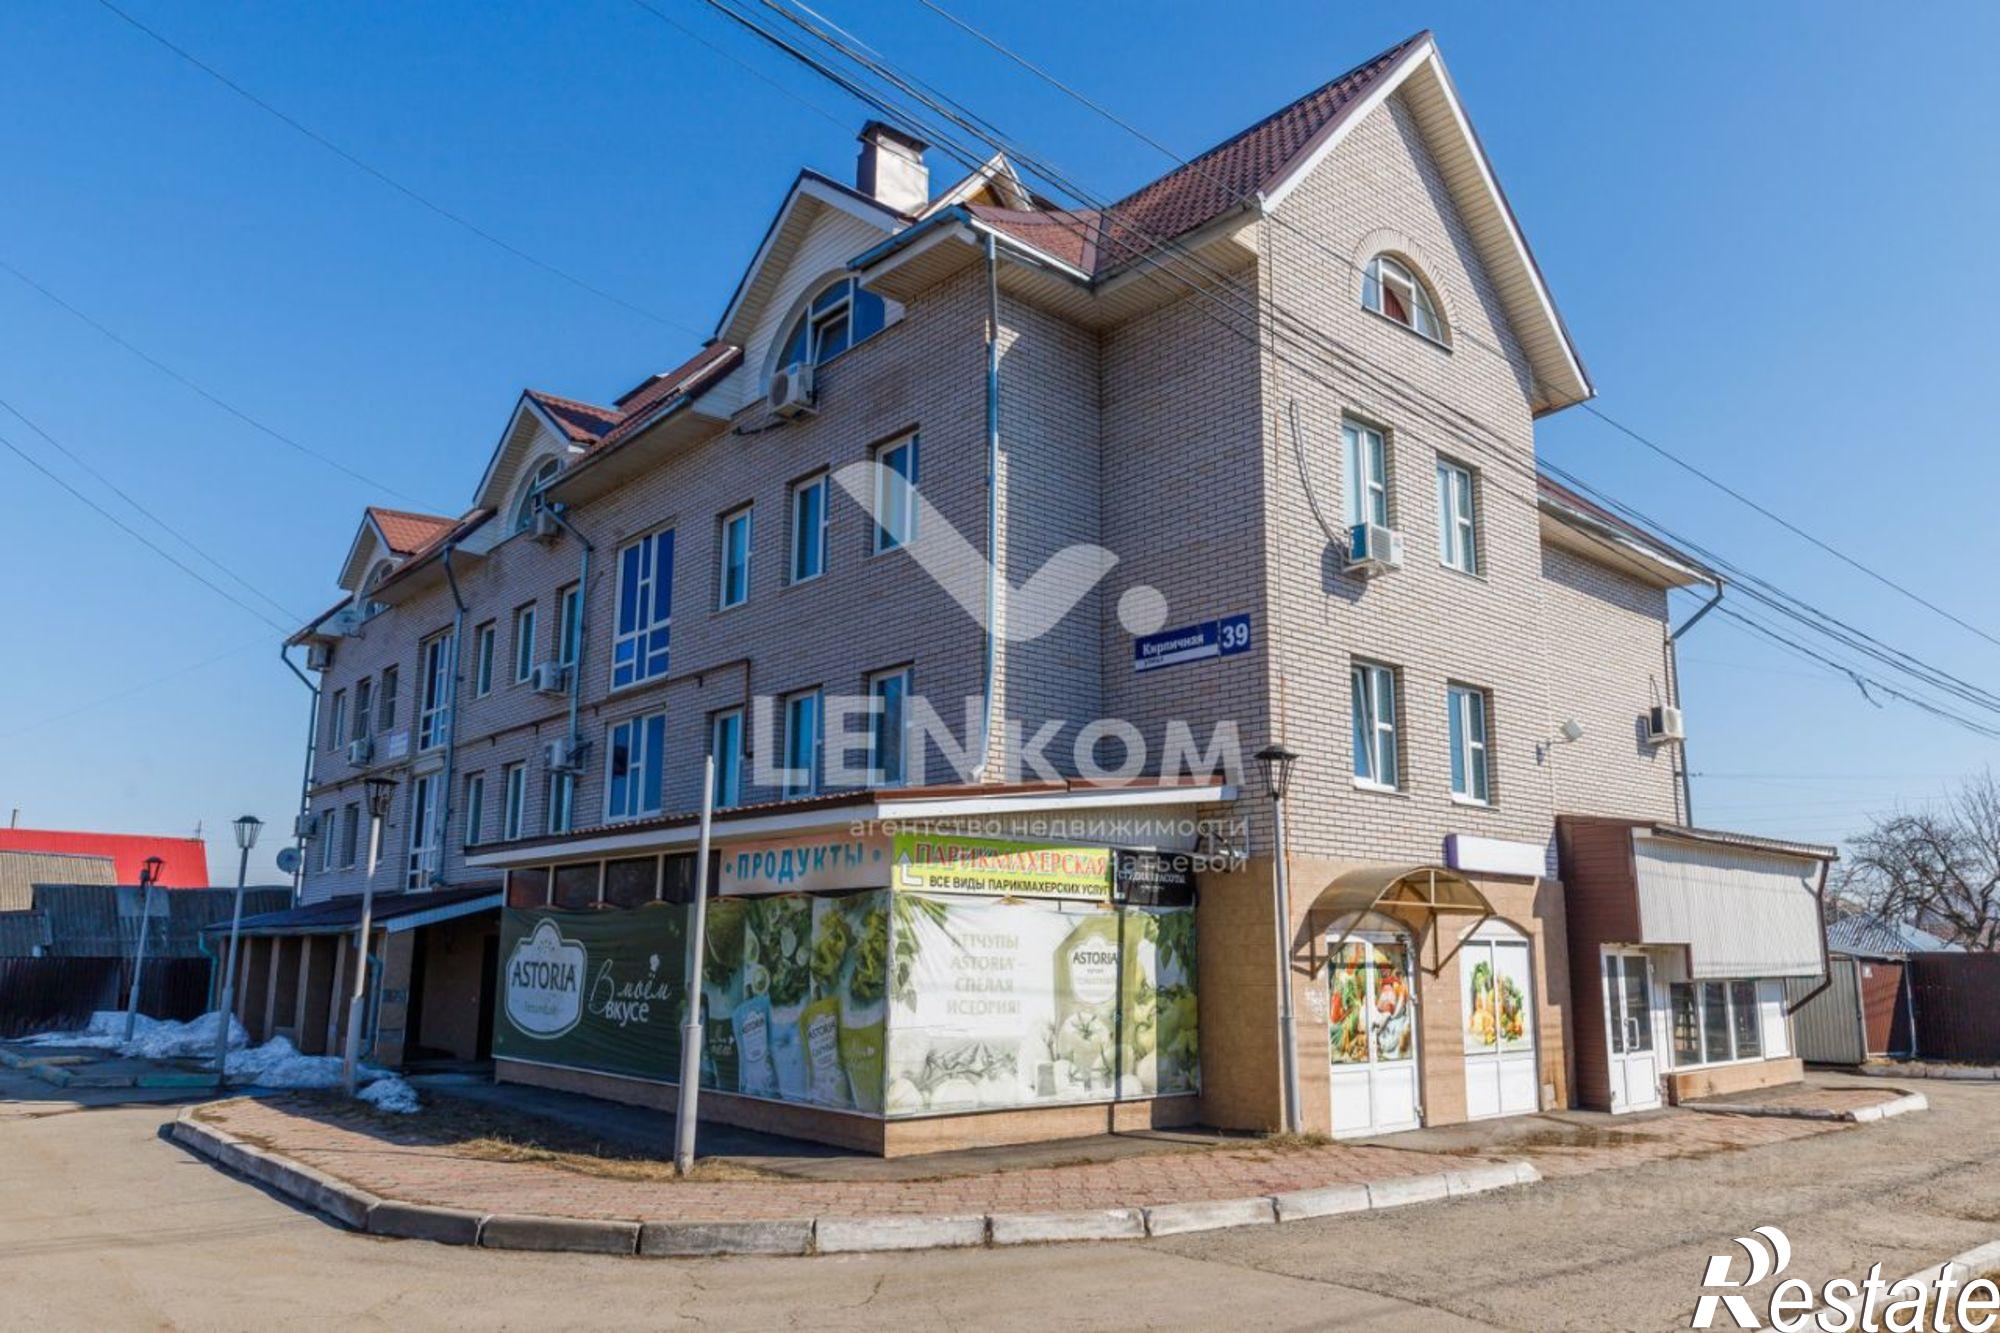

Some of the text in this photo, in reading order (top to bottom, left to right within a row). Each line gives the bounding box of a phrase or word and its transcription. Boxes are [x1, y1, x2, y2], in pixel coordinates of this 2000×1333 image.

[1143, 623, 1248, 656] Кирпичная 39
[737, 842, 863, 884] ПРОДУКТЫ
[915, 841, 1108, 876] ПАРИКМАХЕРСКАЯ
[929, 876, 950, 889] ВСЕ
[952, 877, 985, 891] ВИДЫ
[988, 879, 1081, 894] ПАРИКМАХЕРСКИХ
[1073, 951, 1118, 965] ASTORIA
[512, 960, 576, 992] ASTORIA
[605, 1000, 649, 1027] вкусе
